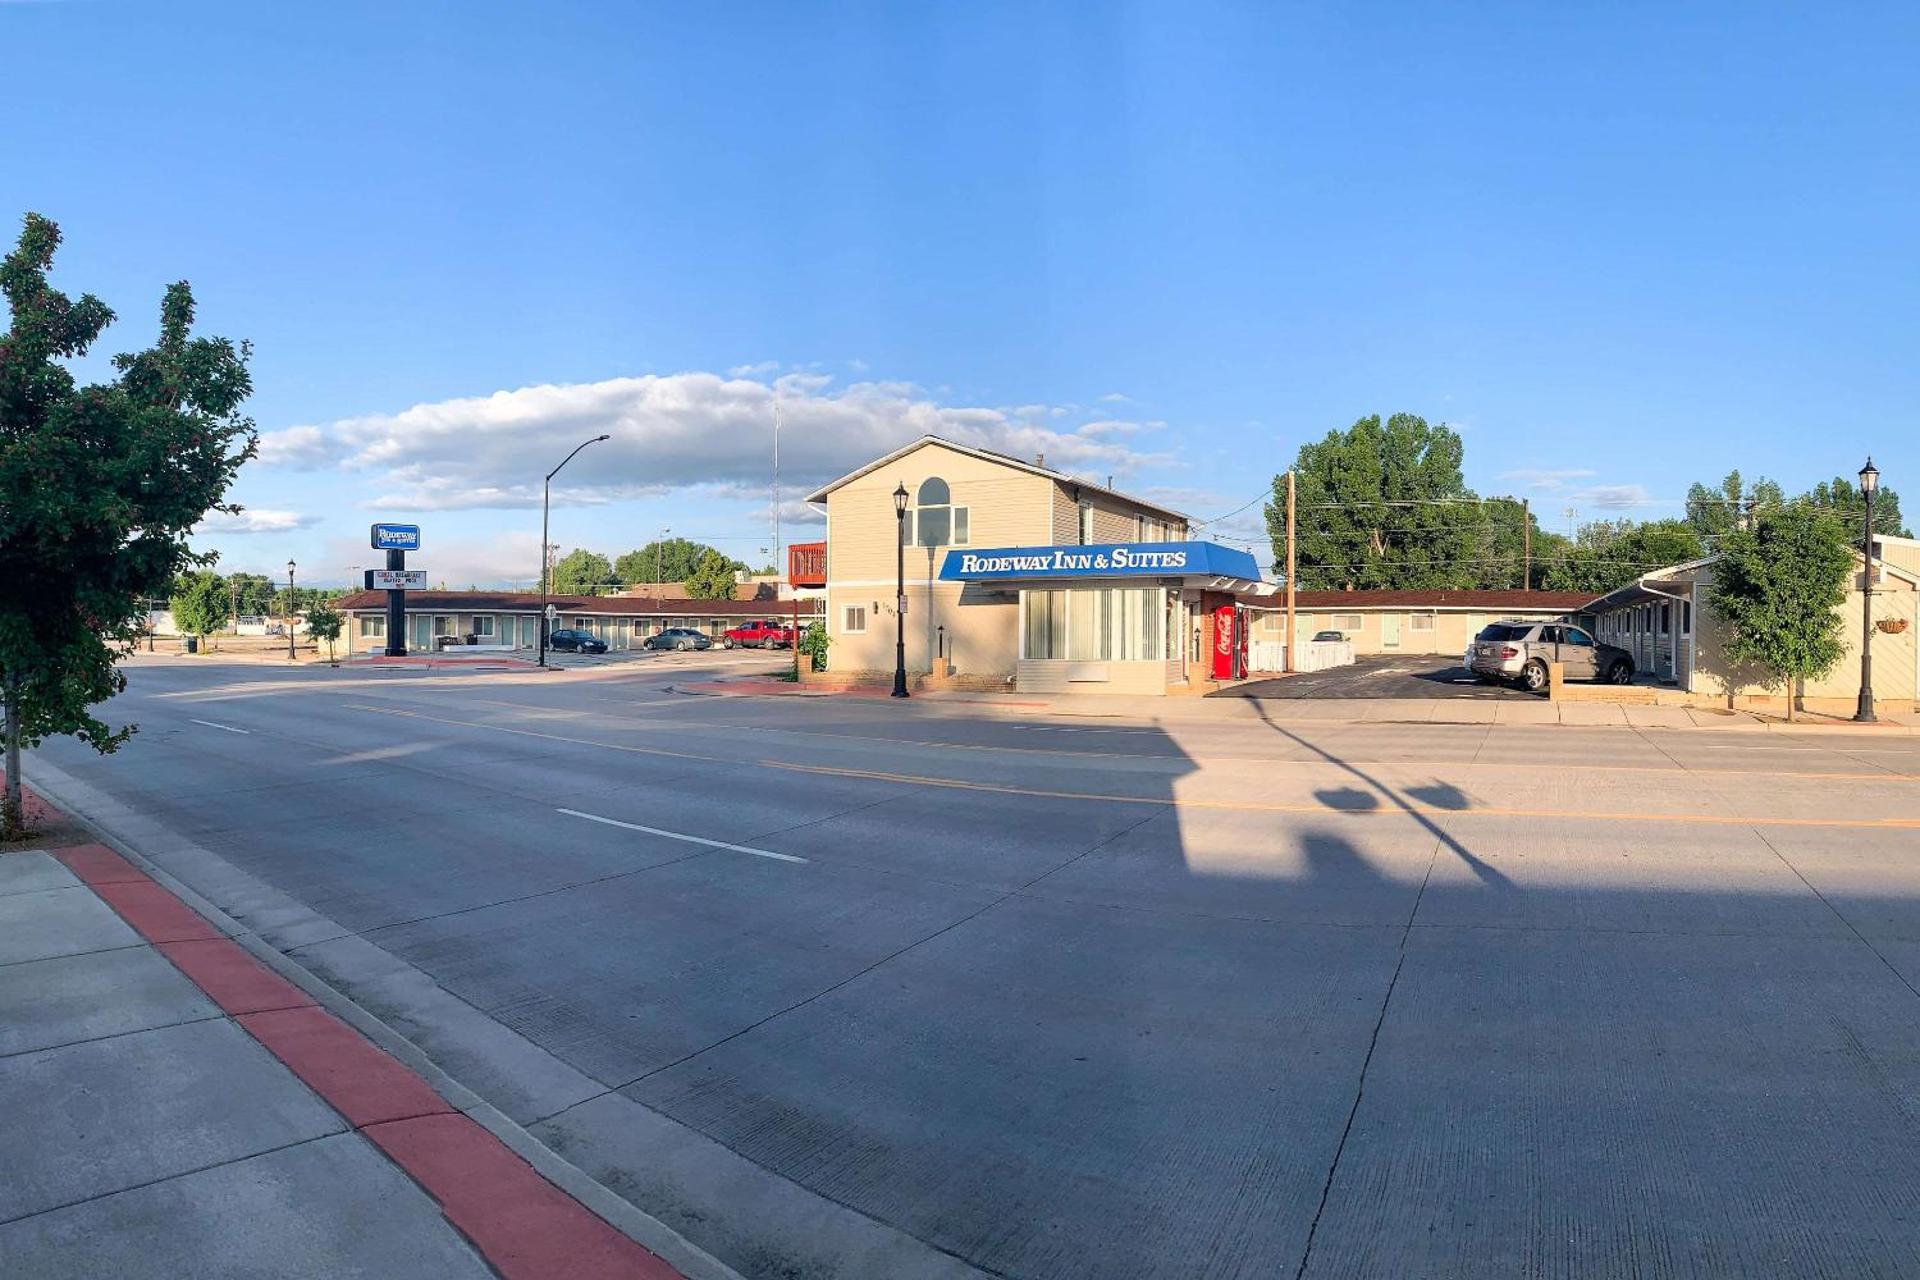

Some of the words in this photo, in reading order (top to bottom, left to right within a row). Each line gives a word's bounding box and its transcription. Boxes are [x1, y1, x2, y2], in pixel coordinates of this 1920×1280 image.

[960, 554, 1053, 573] RODEWAY
[1053, 550, 1093, 569] INN
[1094, 553, 1109, 569] &
[1110, 548, 1187, 568] SUITES
